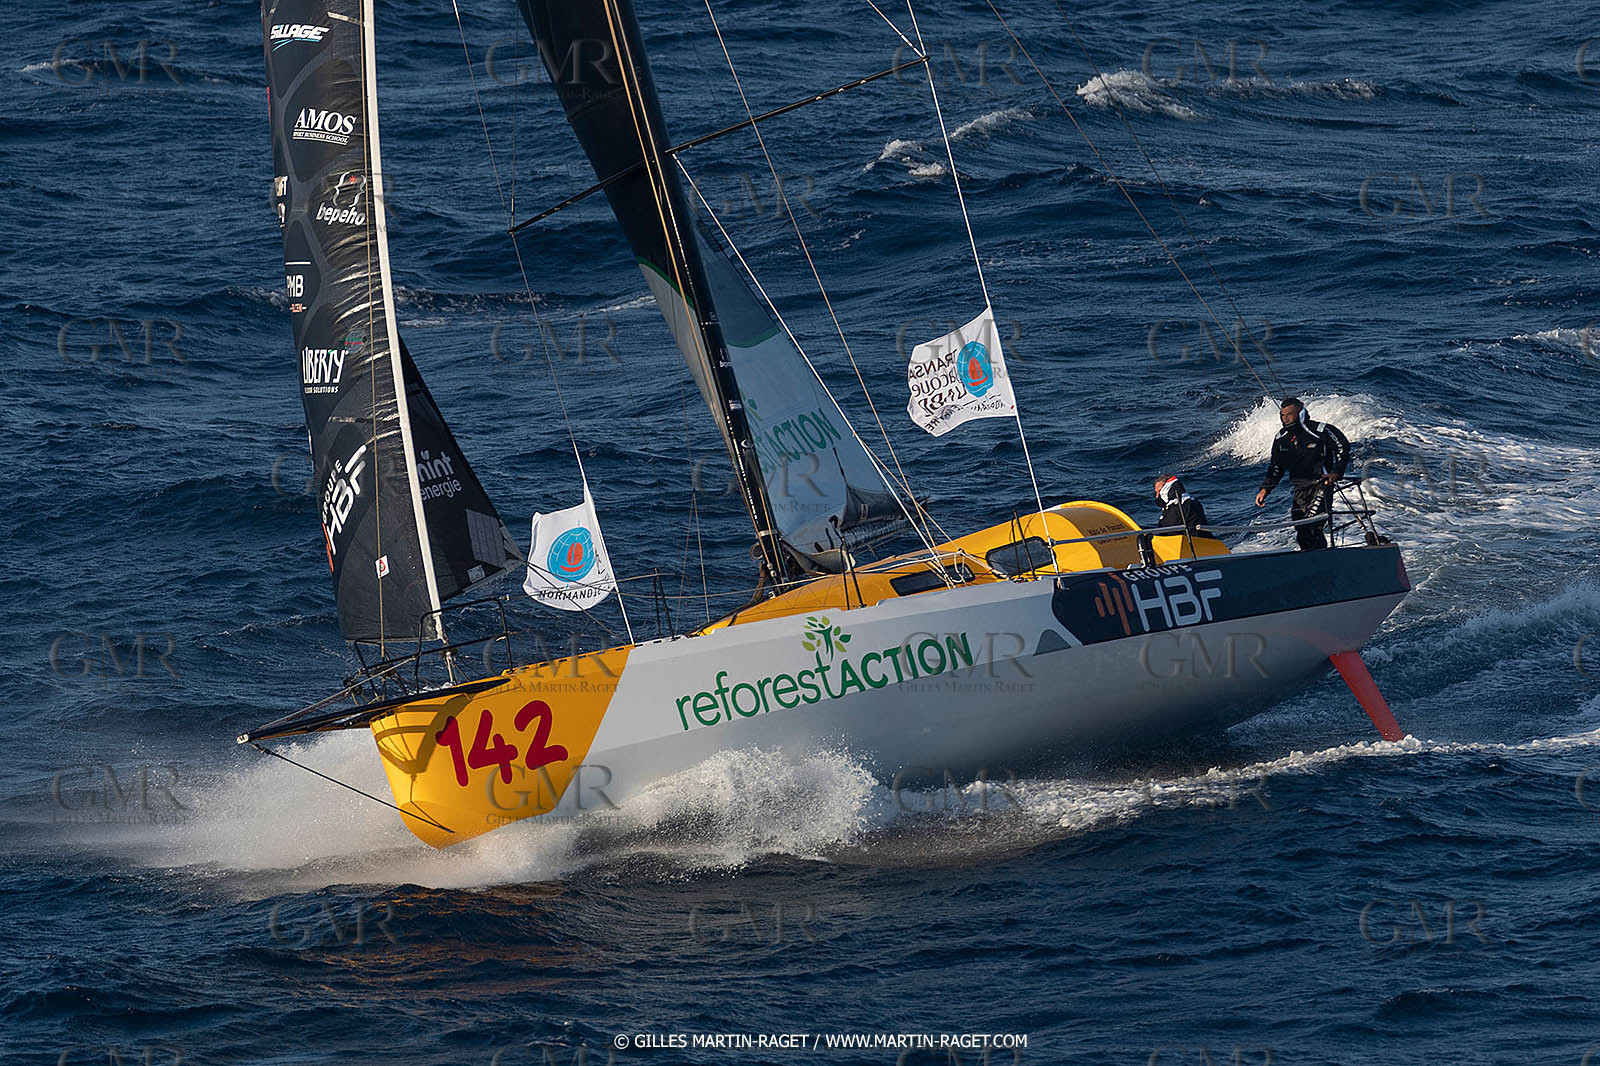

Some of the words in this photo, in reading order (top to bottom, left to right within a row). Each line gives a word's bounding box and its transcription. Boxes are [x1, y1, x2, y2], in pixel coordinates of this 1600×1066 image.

[294, 108, 357, 135] AMOS
[326, 134, 349, 144] SCHOOL
[316, 202, 366, 226] bepeho
[302, 346, 346, 384] LIBERTY
[420, 477, 462, 500] energie
[1122, 564, 1193, 582] GROUPE
[1131, 570, 1222, 632] HBF
[435, 699, 568, 787] 142
